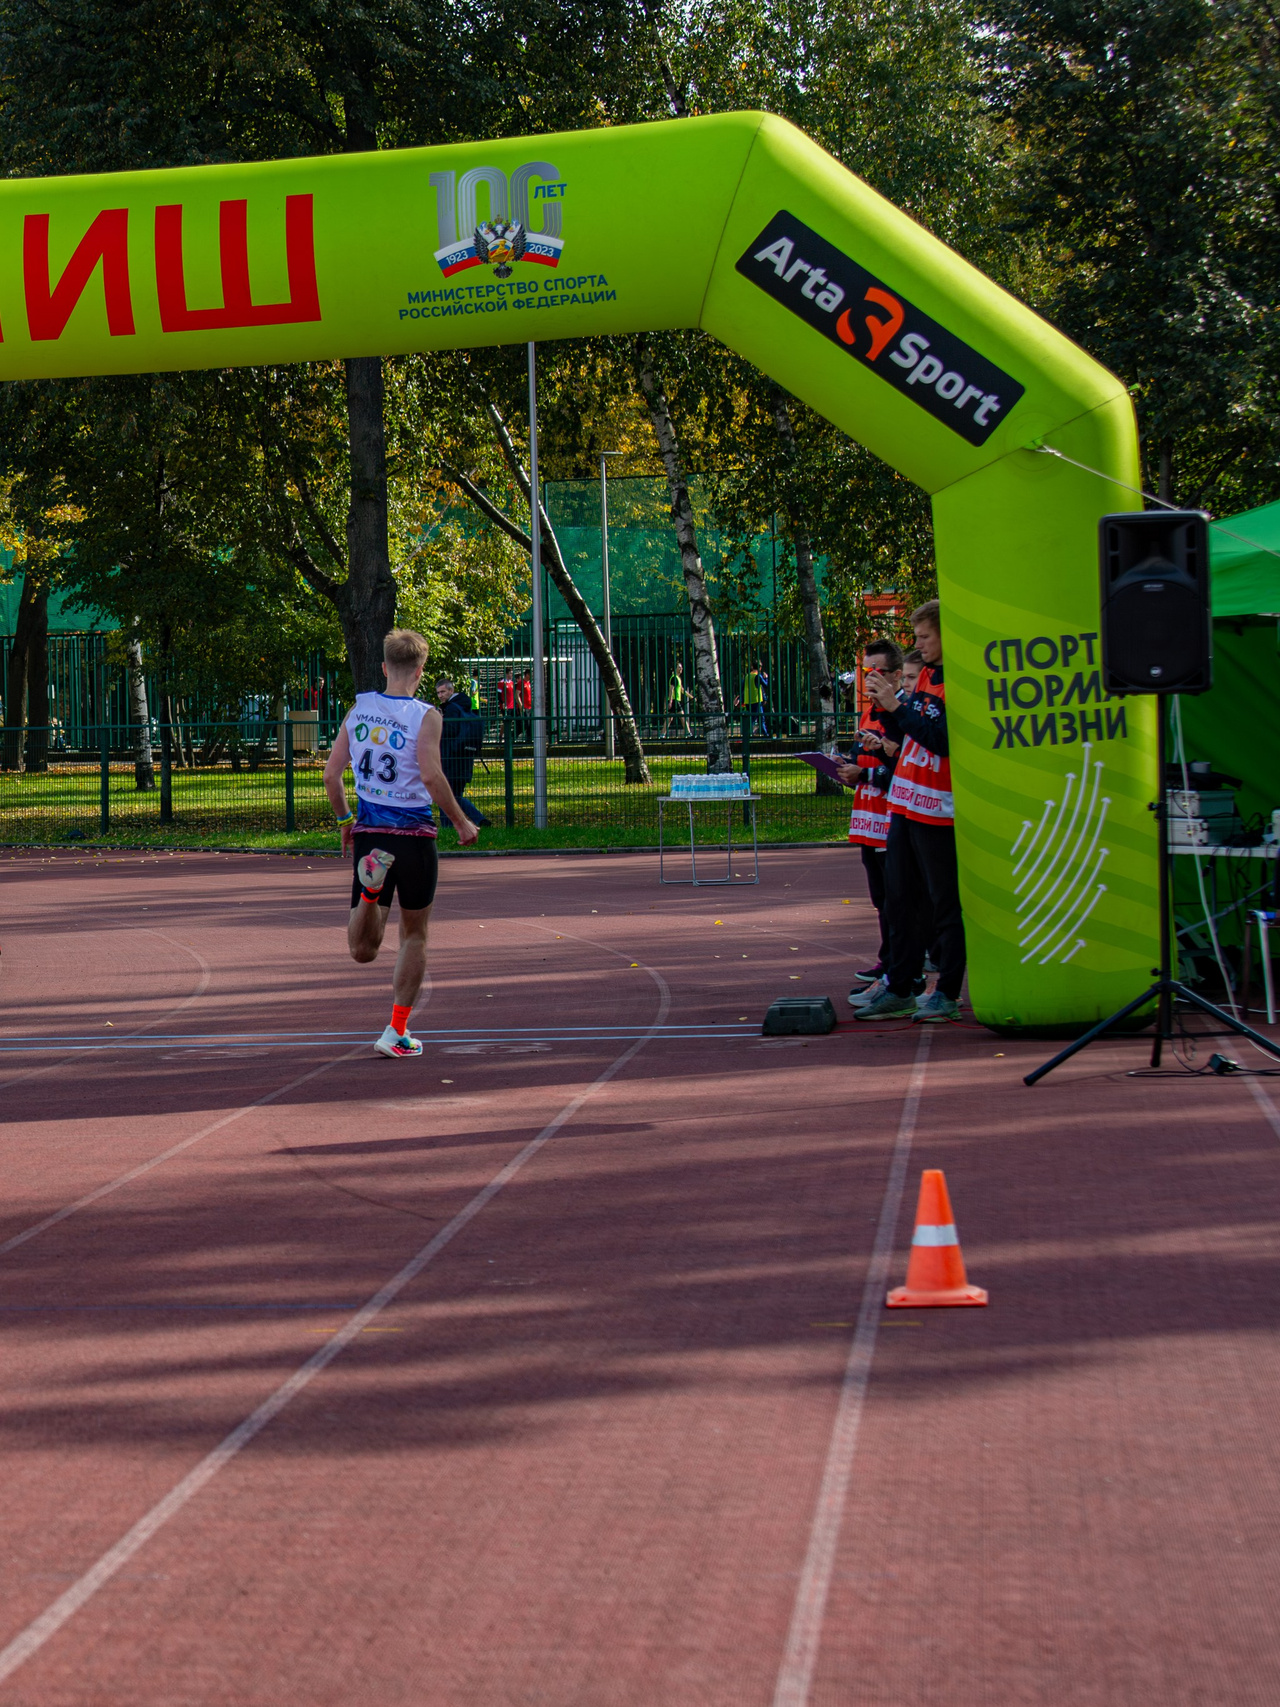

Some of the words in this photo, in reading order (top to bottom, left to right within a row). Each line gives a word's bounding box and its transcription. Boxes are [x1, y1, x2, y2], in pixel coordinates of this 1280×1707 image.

[533, 183, 568, 199] ЛЕТ
[445, 250, 469, 266] 1923
[528, 243, 555, 257] 2023
[407, 281, 539, 304] МИНИСТЕРСТВО
[543, 274, 609, 293] СПОРТА
[398, 296, 508, 321] РОССИЙСКОЙ
[512, 289, 618, 310] ФЕДЕРАЦИИ
[753, 236, 845, 313] Arta
[888, 332, 1001, 427] Sport
[984, 631, 1098, 673] СПОРТ
[986, 670, 1112, 711] НОРМ
[355, 713, 408, 733] VMARAFONE
[990, 706, 1128, 749] ЖИЗНИ
[358, 748, 398, 785] 43
[913, 793, 942, 812] СПОРТ
